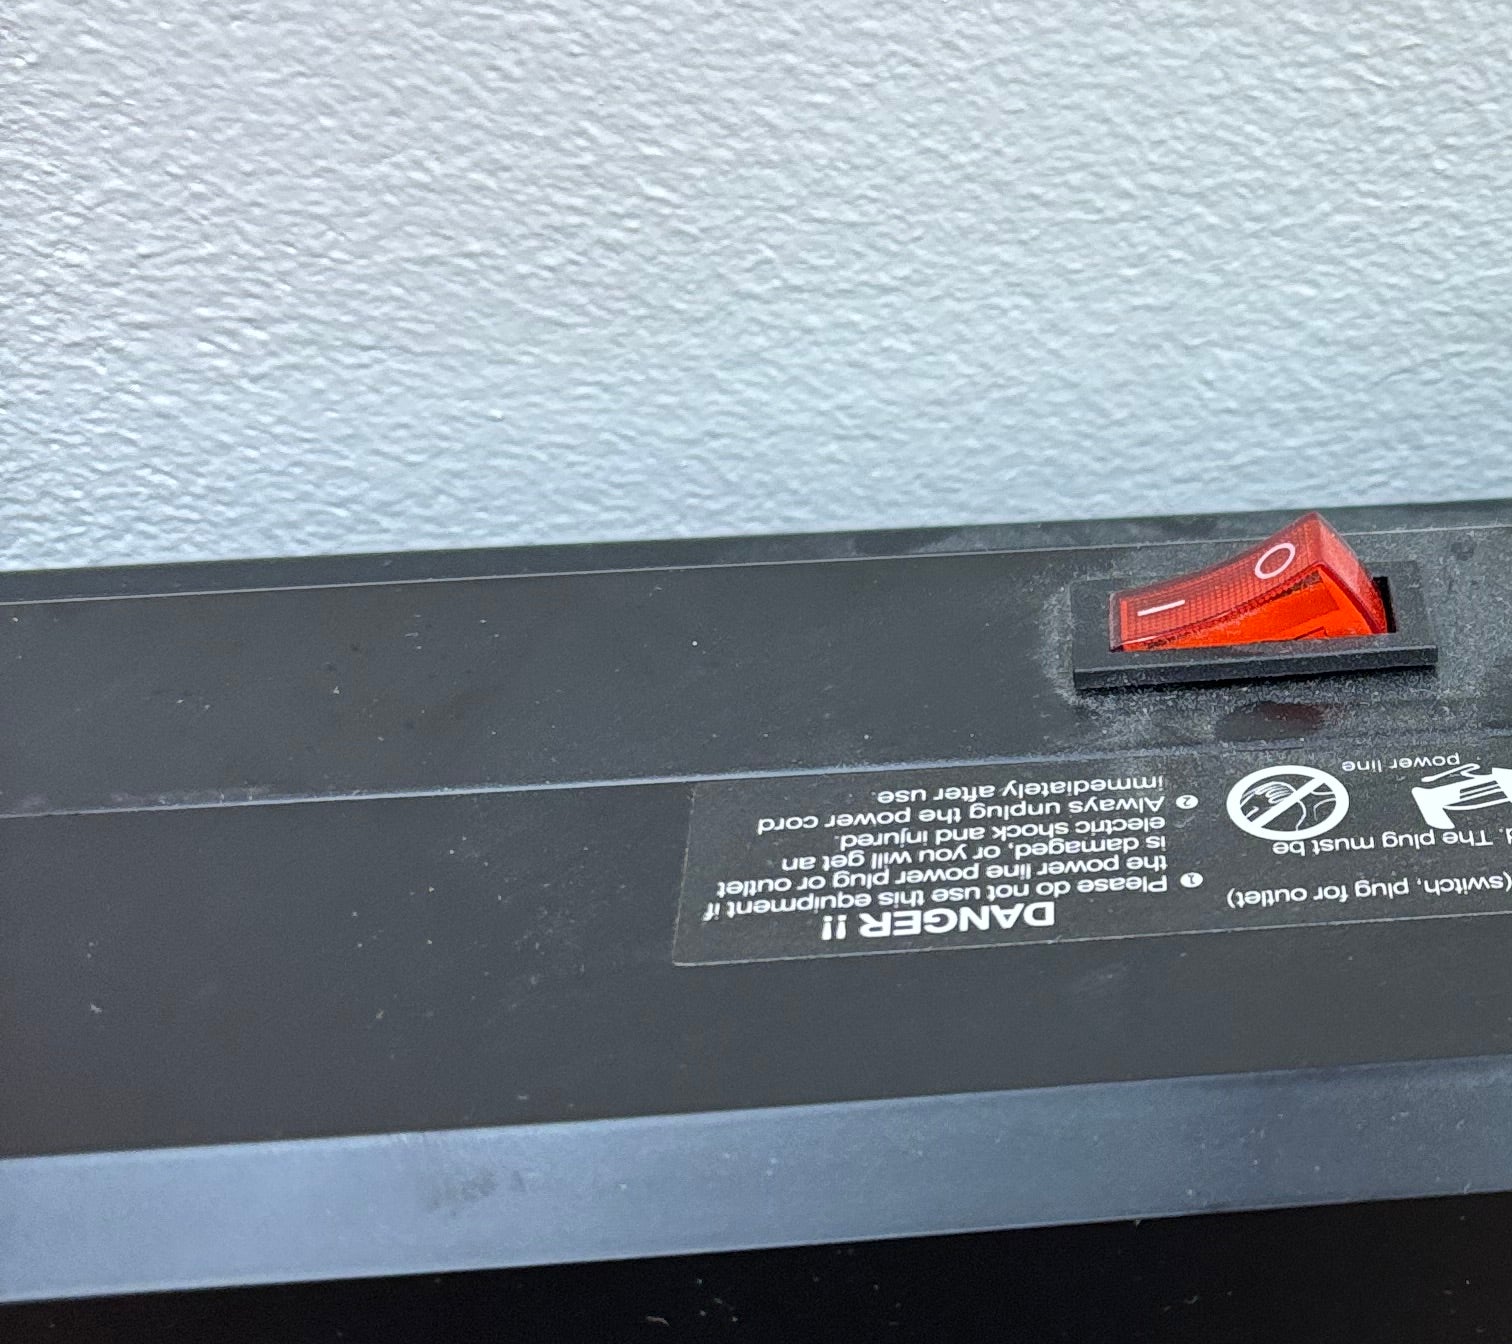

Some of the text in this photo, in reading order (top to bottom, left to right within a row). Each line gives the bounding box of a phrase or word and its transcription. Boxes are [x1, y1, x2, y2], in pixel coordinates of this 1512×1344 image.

[1341, 752, 1461, 773] power line
[872, 775, 1163, 804] immediately after use.
[969, 800, 1061, 821] unplug
[1067, 795, 1165, 814] Always
[757, 815, 819, 836] cord
[823, 806, 911, 828] power
[918, 807, 962, 825] the
[834, 816, 1166, 851] electric shock and injured.
[1381, 829, 1436, 850] plug
[1442, 829, 1494, 847] The
[781, 835, 1166, 872] is damaged, or you will get an
[1272, 841, 1306, 857] be
[1312, 836, 1375, 856] must
[716, 854, 1169, 899] the power line power plug or outlet
[1076, 874, 1168, 893] Please
[1416, 871, 1512, 896] (switch,
[877, 889, 925, 907] this
[930, 886, 981, 902] use
[986, 883, 1030, 901] not
[1035, 880, 1071, 898] do
[1226, 887, 1308, 909] outlet)
[1312, 885, 1349, 903] for
[1354, 877, 1410, 900] plug
[702, 902, 721, 922] if
[726, 891, 872, 919] equipment
[821, 901, 1055, 941] DANGER !!
